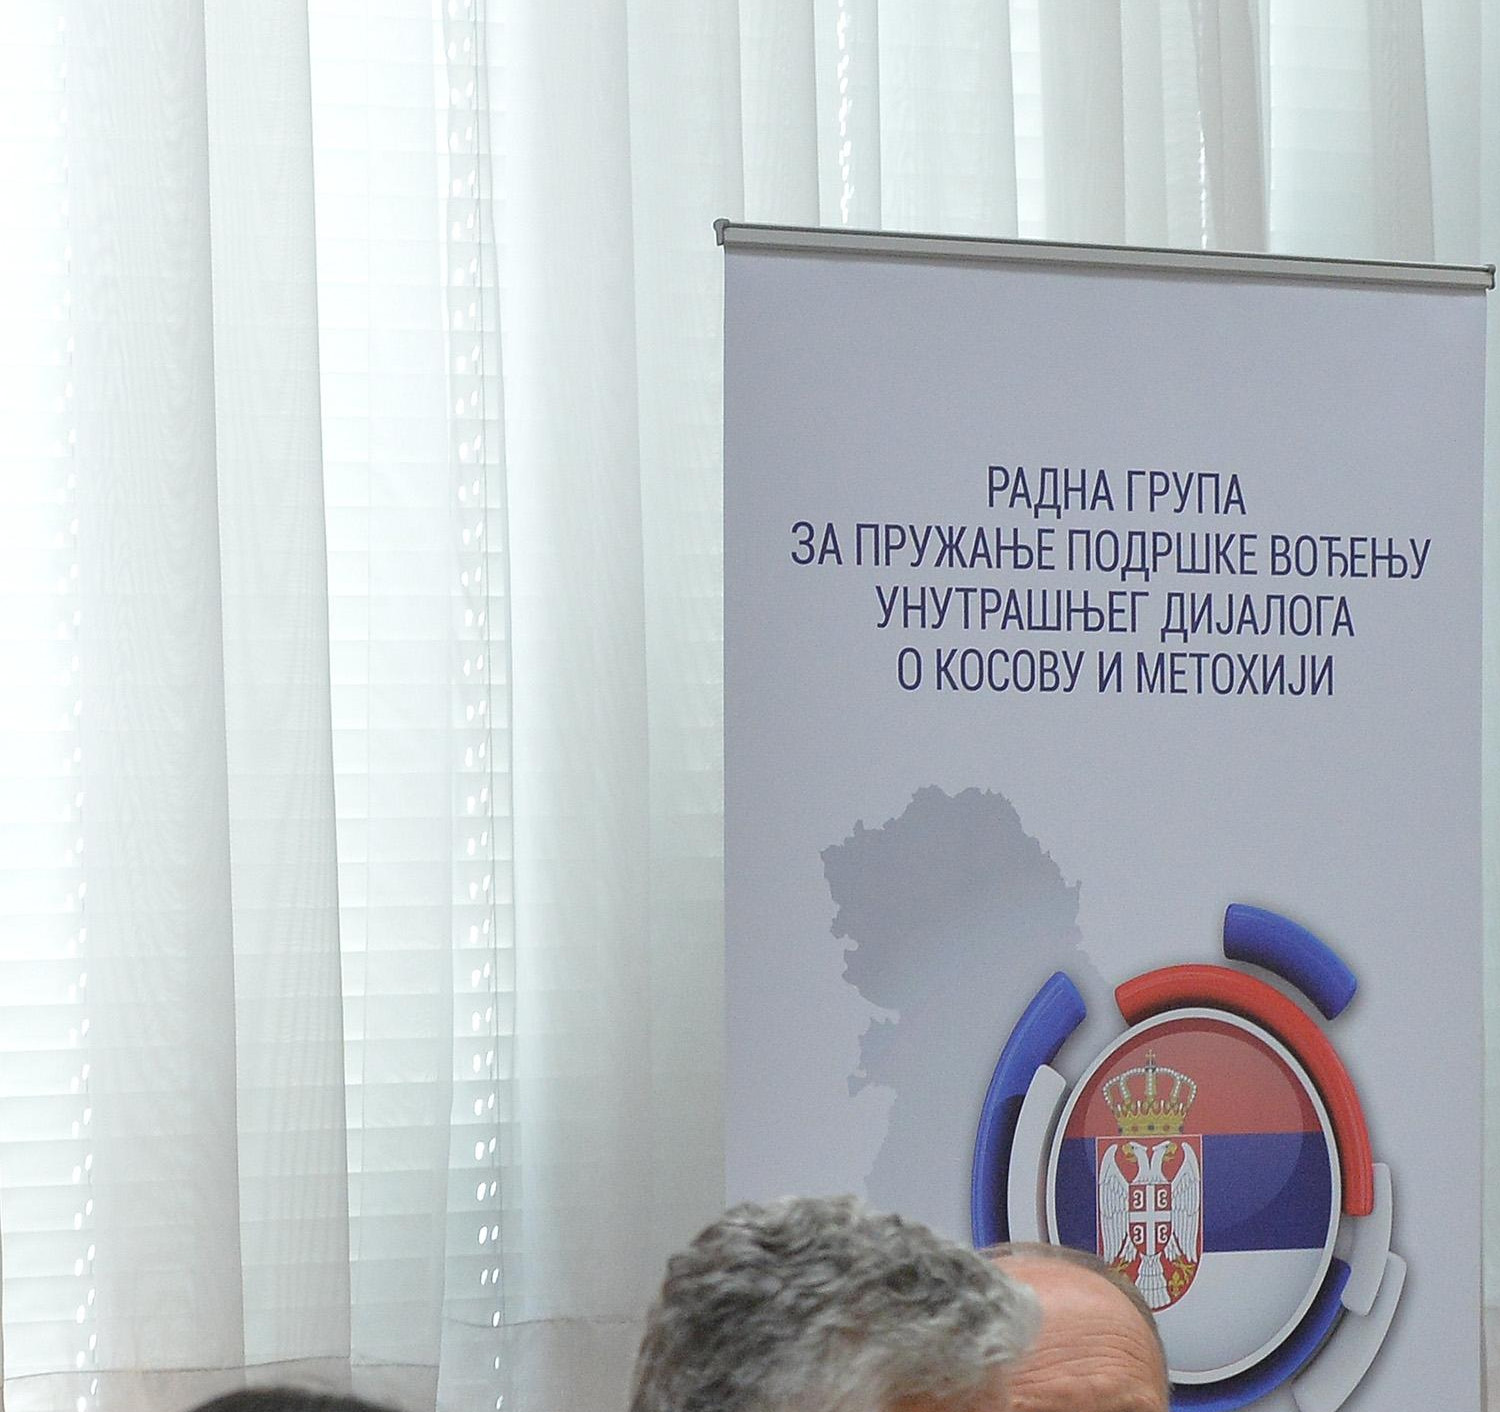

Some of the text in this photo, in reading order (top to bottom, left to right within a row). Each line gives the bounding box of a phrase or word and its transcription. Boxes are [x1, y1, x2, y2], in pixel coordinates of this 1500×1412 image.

[989, 466, 1246, 519] РАДНА ГРУПА
[792, 522, 1431, 582] ЗА ПРУЖАЊЕ ПОДРШКЕ ВОЂЕЊУ
[876, 586, 1354, 643] УНУТРАШЊЕГ ДИЈАЛОГА
[898, 648, 1333, 695] О КОСОВУ И МЕТОХИЈИ
